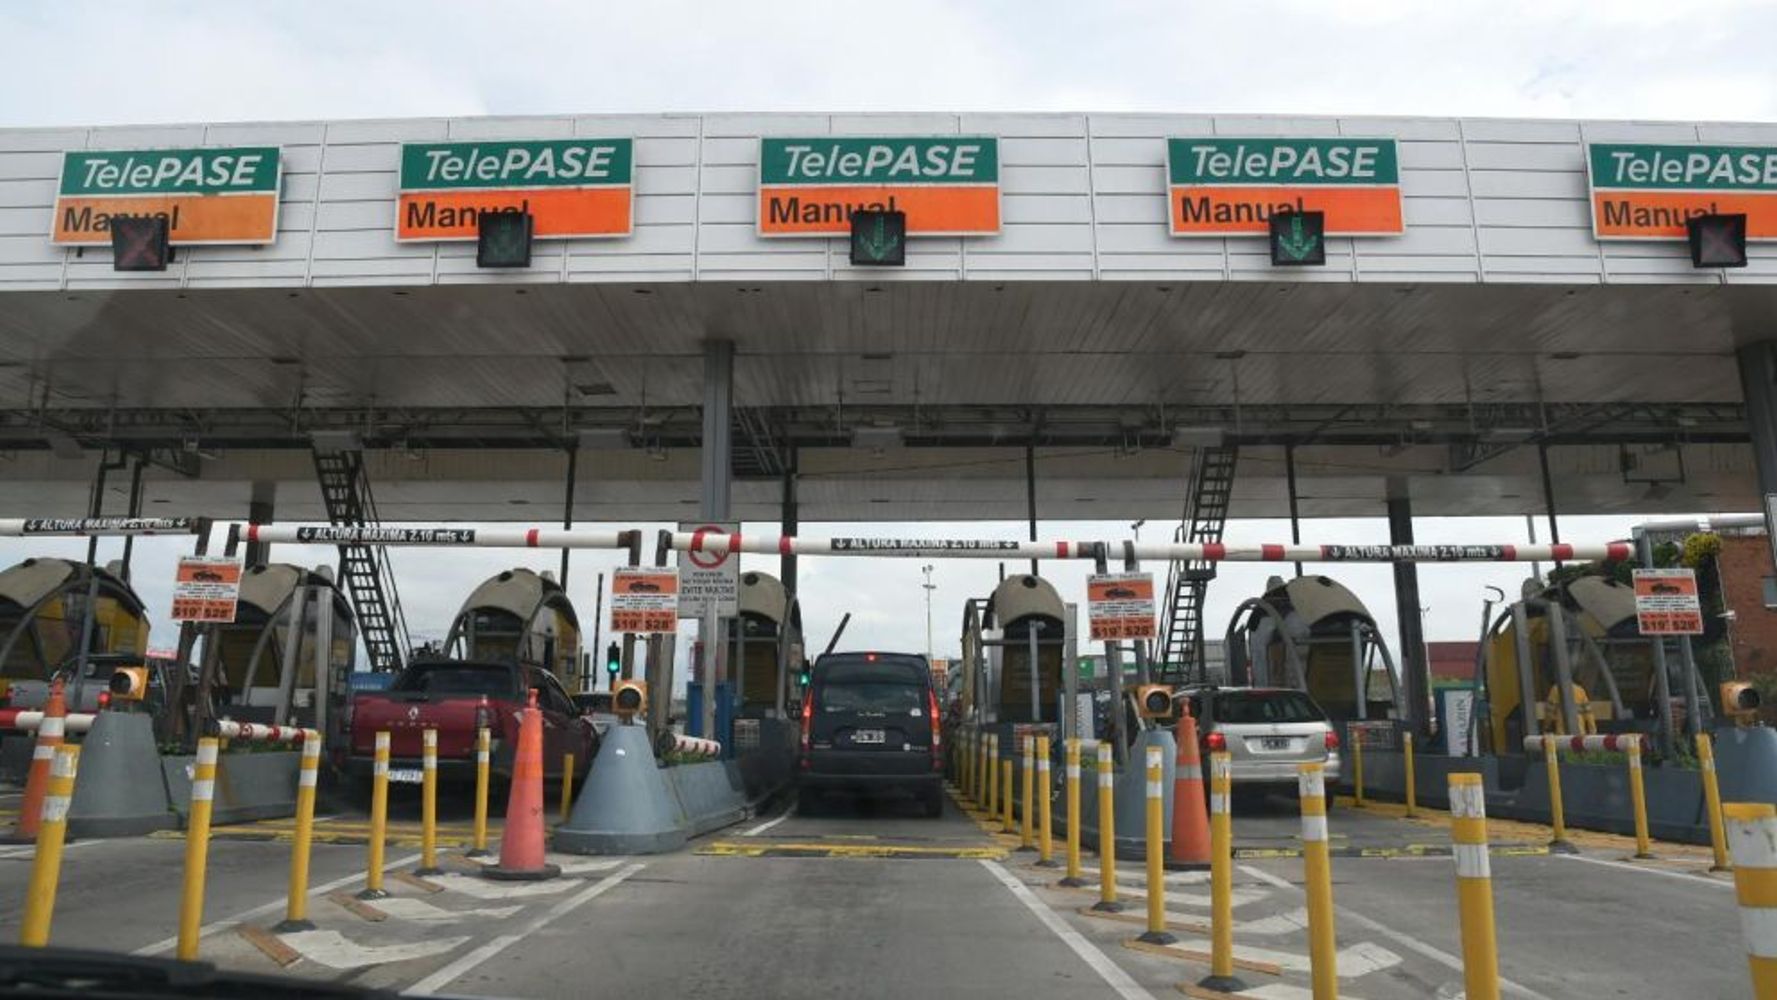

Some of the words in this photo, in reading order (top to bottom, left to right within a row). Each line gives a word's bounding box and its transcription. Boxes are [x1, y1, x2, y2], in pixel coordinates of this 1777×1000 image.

[83, 156, 262, 188] TelePASE
[426, 147, 616, 181] TelePASE
[784, 145, 980, 177] TelePASE
[1191, 146, 1379, 177] TelePASE
[315, 527, 358, 540] ALTURA
[1345, 546, 1388, 558] ALTURA
